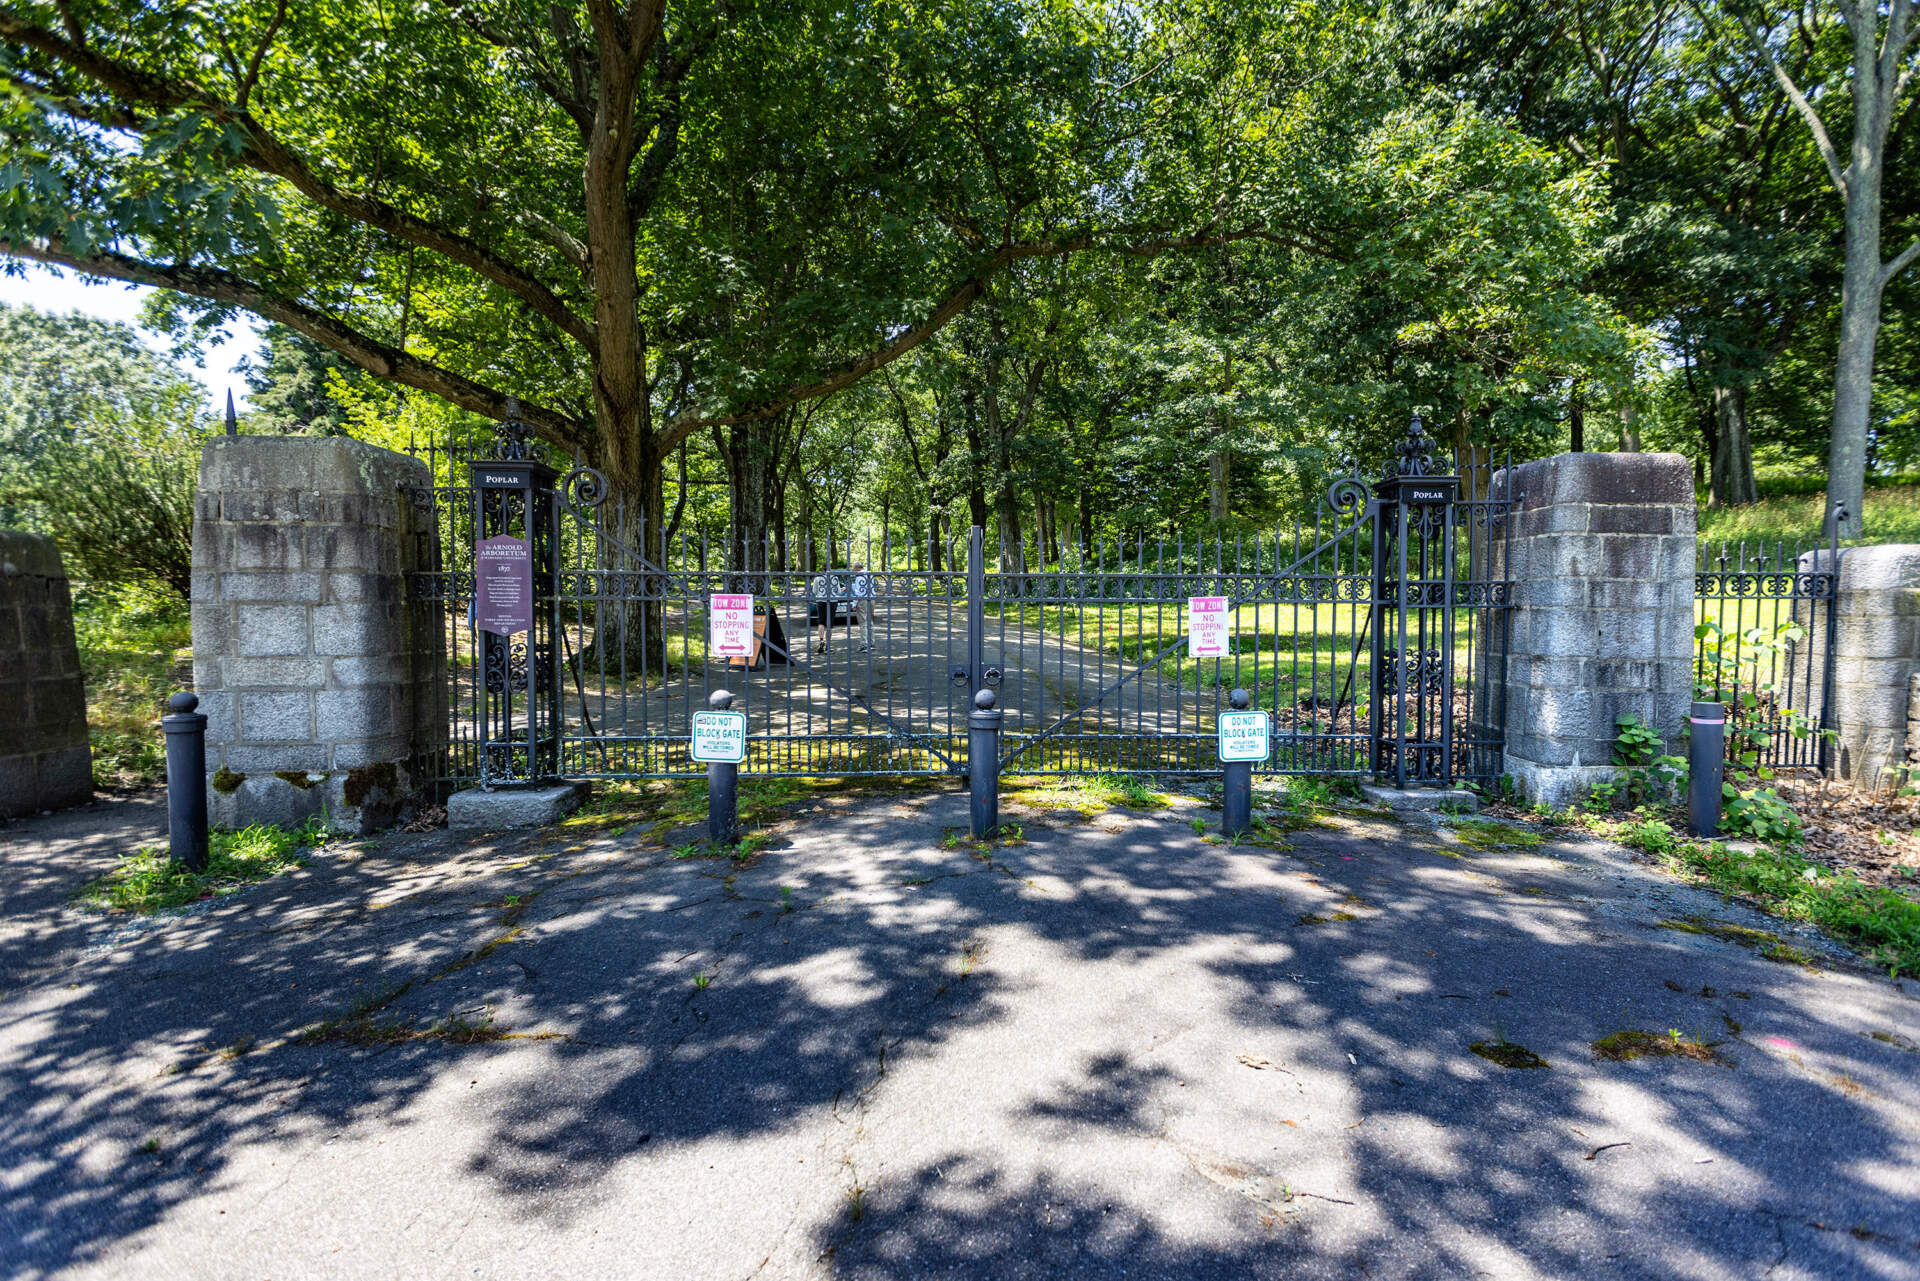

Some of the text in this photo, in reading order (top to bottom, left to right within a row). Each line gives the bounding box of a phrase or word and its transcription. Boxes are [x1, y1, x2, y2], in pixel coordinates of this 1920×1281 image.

[485, 475, 519, 484] POPLAR
[1413, 491, 1443, 499] POPLAR
[713, 599, 729, 609] TOW
[726, 612, 738, 620] NO
[1202, 614, 1215, 622] NO
[706, 716, 732, 727] DO NOT
[1231, 716, 1257, 726] DO NOT
[697, 728, 741, 738] BLOCK GATE
[1223, 728, 1264, 738] BLOCK GATE
